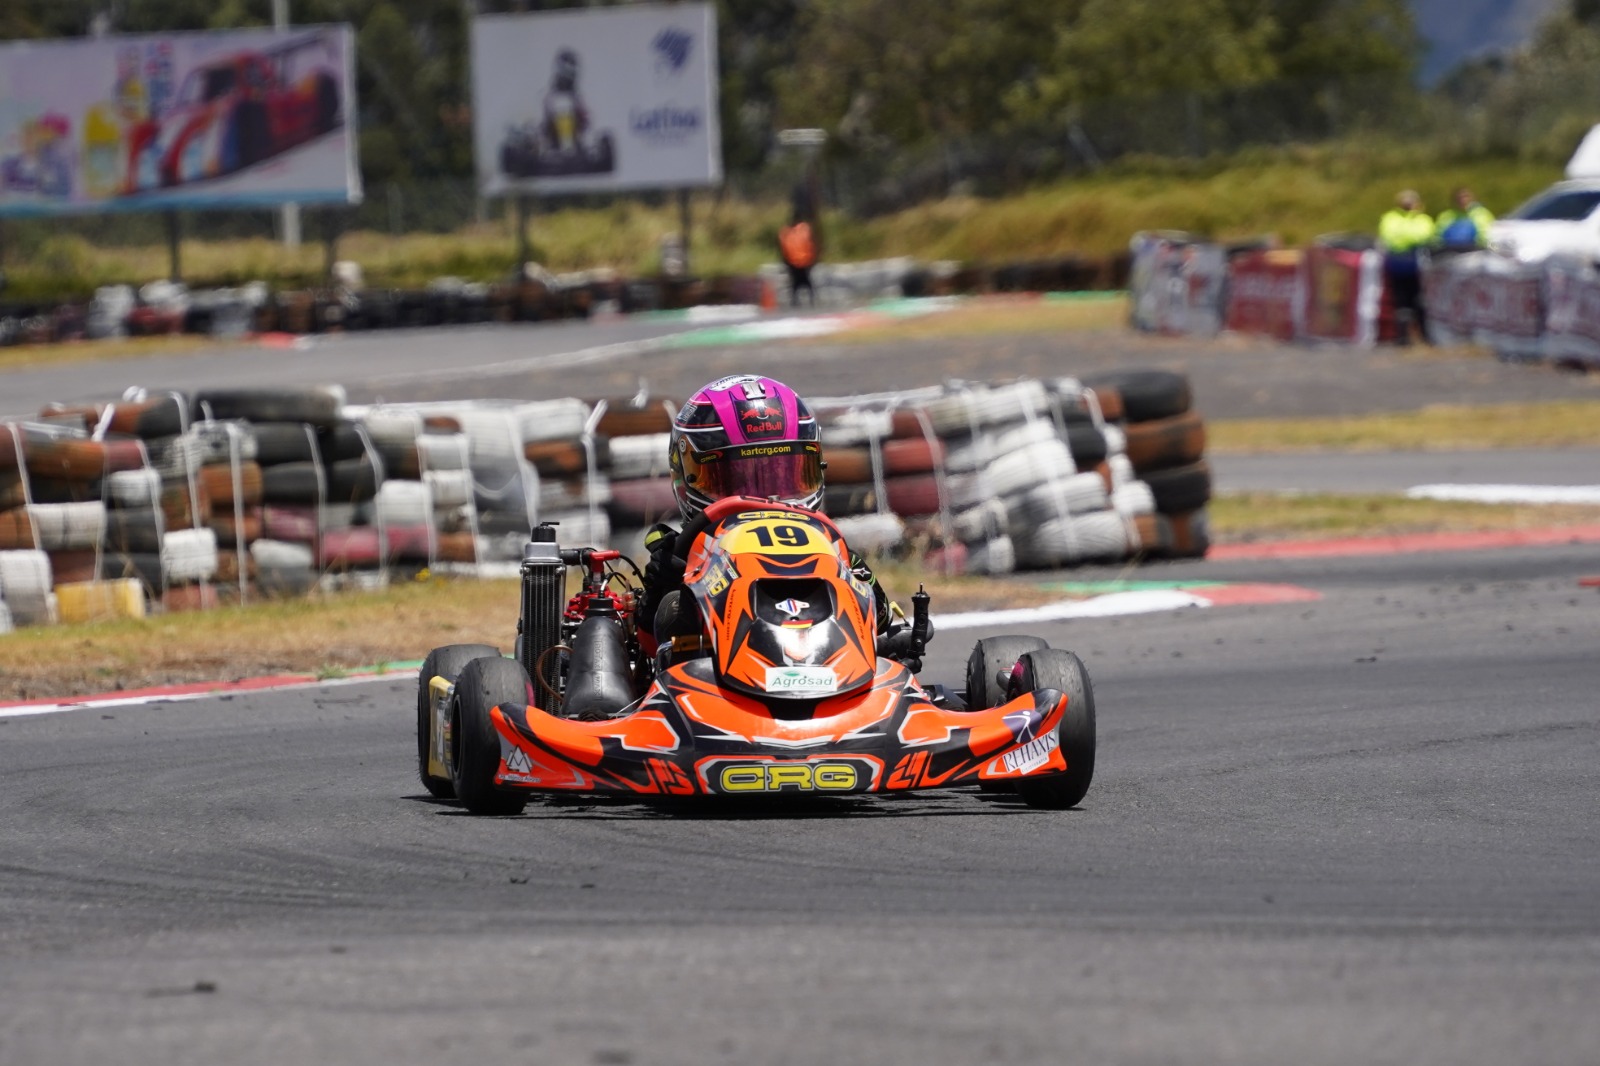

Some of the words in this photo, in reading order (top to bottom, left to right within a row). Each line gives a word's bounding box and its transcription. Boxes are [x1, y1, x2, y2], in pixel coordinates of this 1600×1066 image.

[746, 422, 765, 433] Red
[765, 421, 783, 431] Bull
[741, 445, 791, 457] kartcrg.com
[737, 511, 810, 521] CRG
[746, 525, 810, 547] 19
[772, 676, 833, 688] Agrosad
[720, 764, 857, 792] CRG
